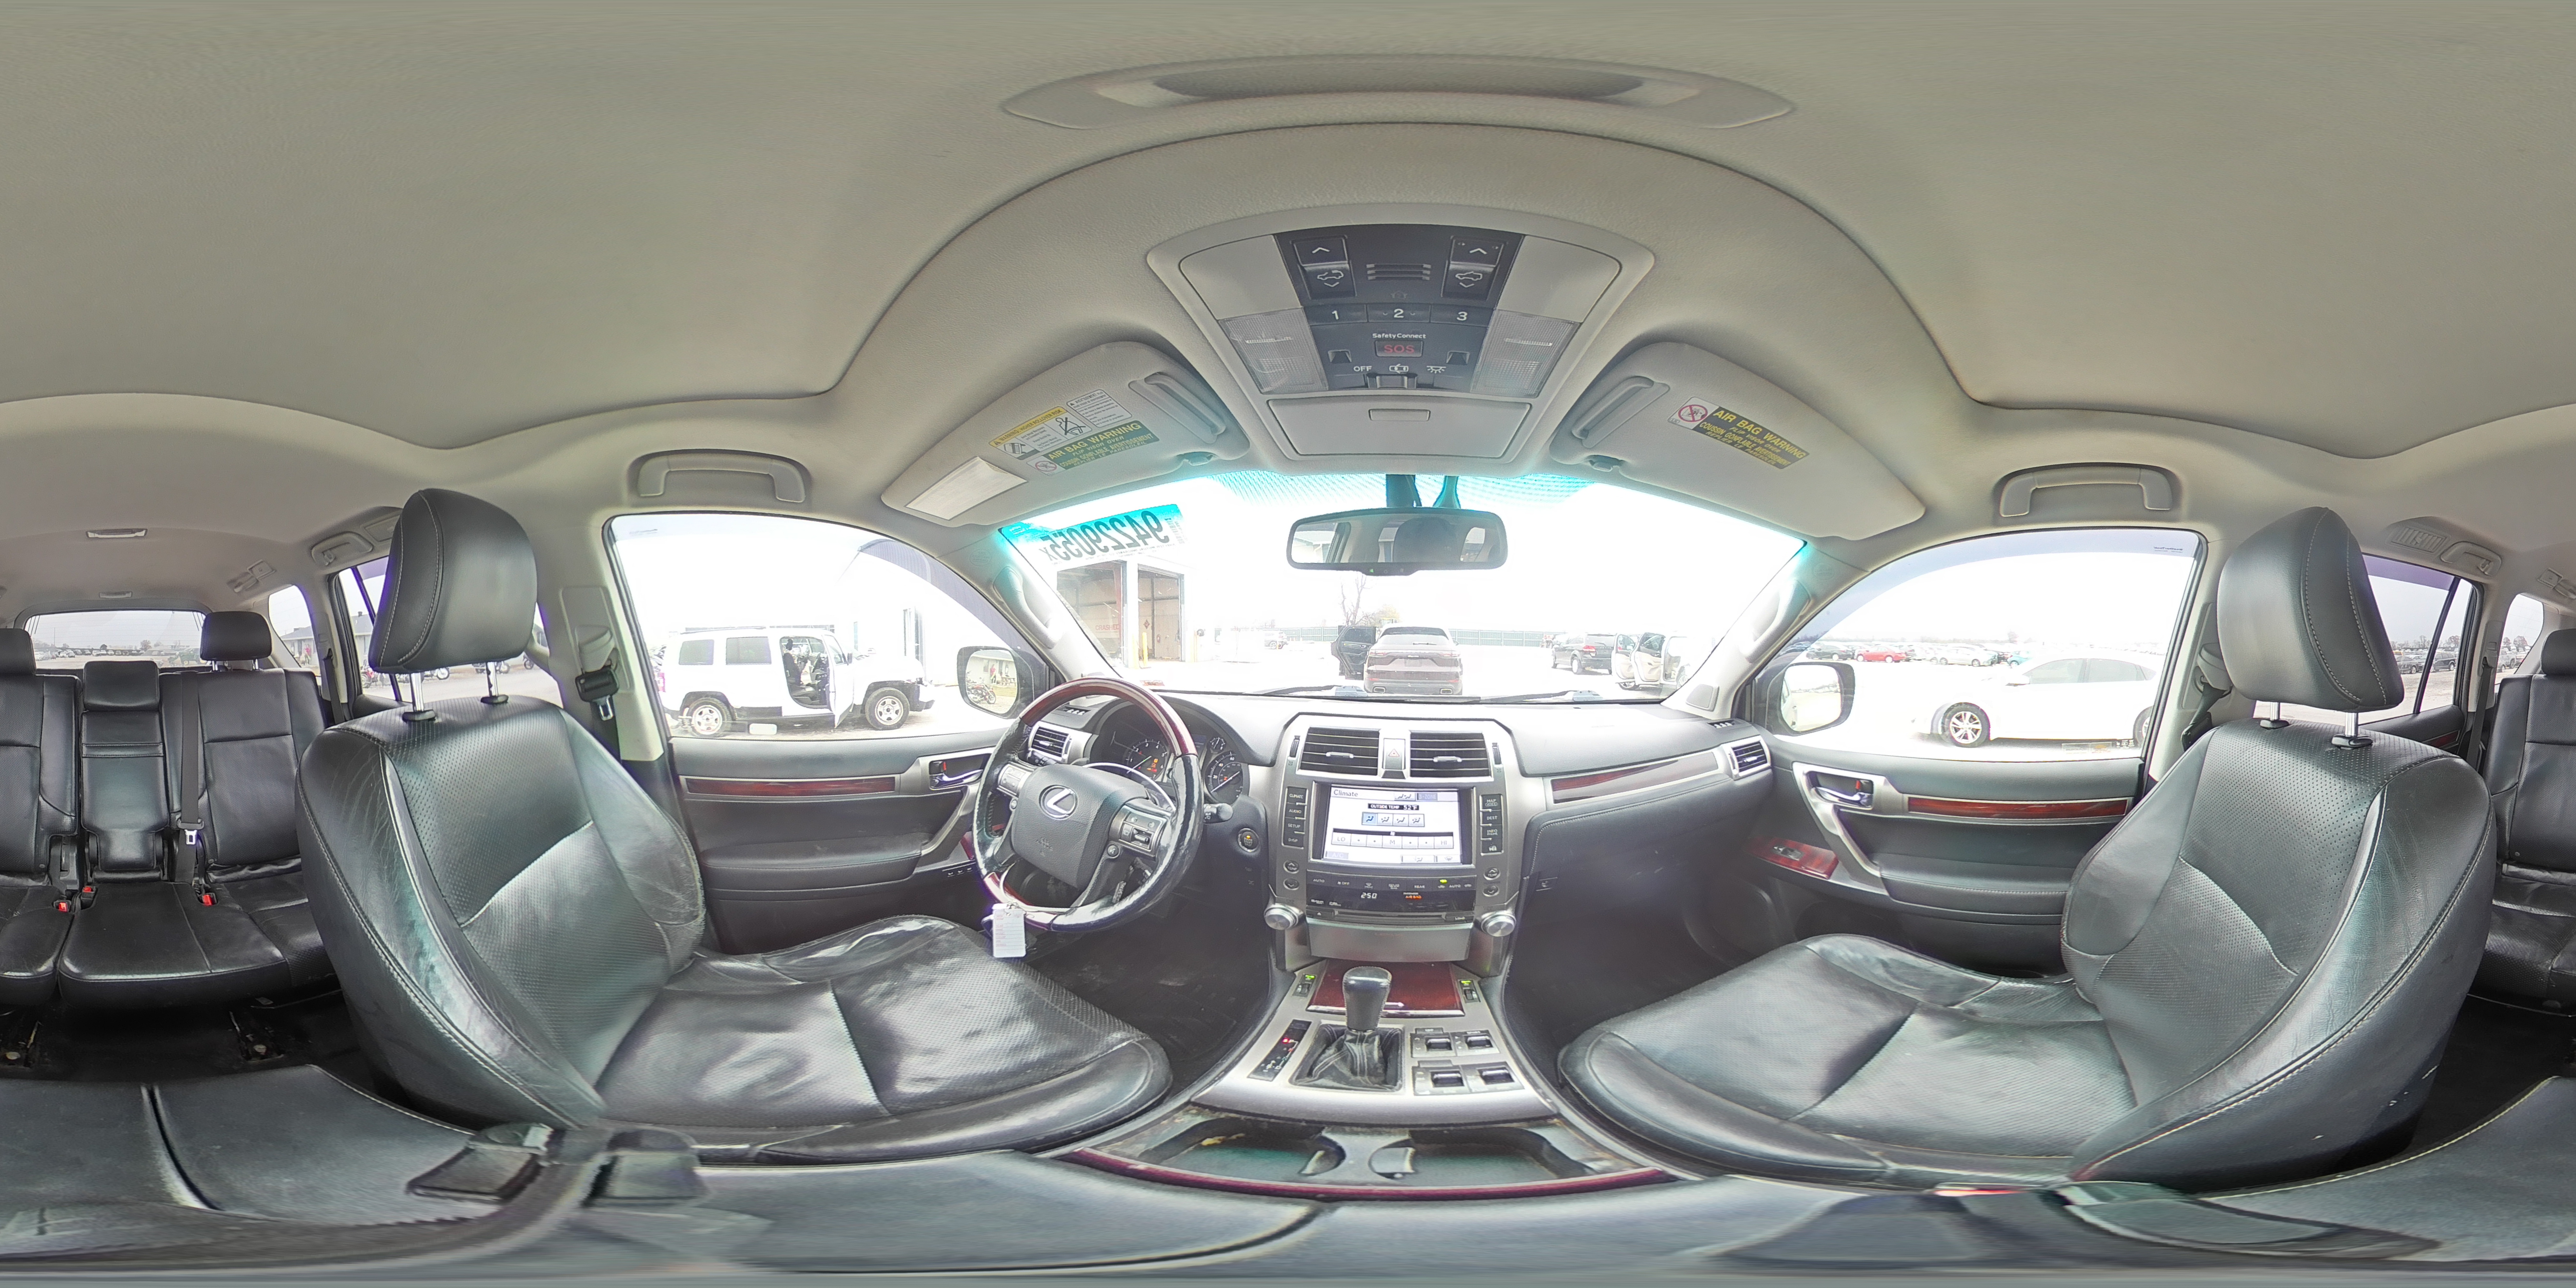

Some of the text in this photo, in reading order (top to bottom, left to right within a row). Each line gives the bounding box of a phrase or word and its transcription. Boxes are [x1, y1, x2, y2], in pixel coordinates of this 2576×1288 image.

[1332, 310, 1339, 320] 1
[1393, 309, 1404, 318] 2
[1456, 311, 1468, 321] 3
[1384, 345, 1414, 354] SOS
[1048, 423, 1142, 460] AIR BAG WARNING
[1071, 436, 1125, 457] FLIP VISOR OVER
[1699, 422, 1792, 466] COUSSIN GONFLABLE AVERTISSEMENT
[1713, 410, 1806, 459] AIR BAG WARNING
[1729, 426, 1782, 453] FLIP VISOR OVER
[1059, 433, 1154, 467] COUSSIN GONFLABLE AVERTISSEMENT
